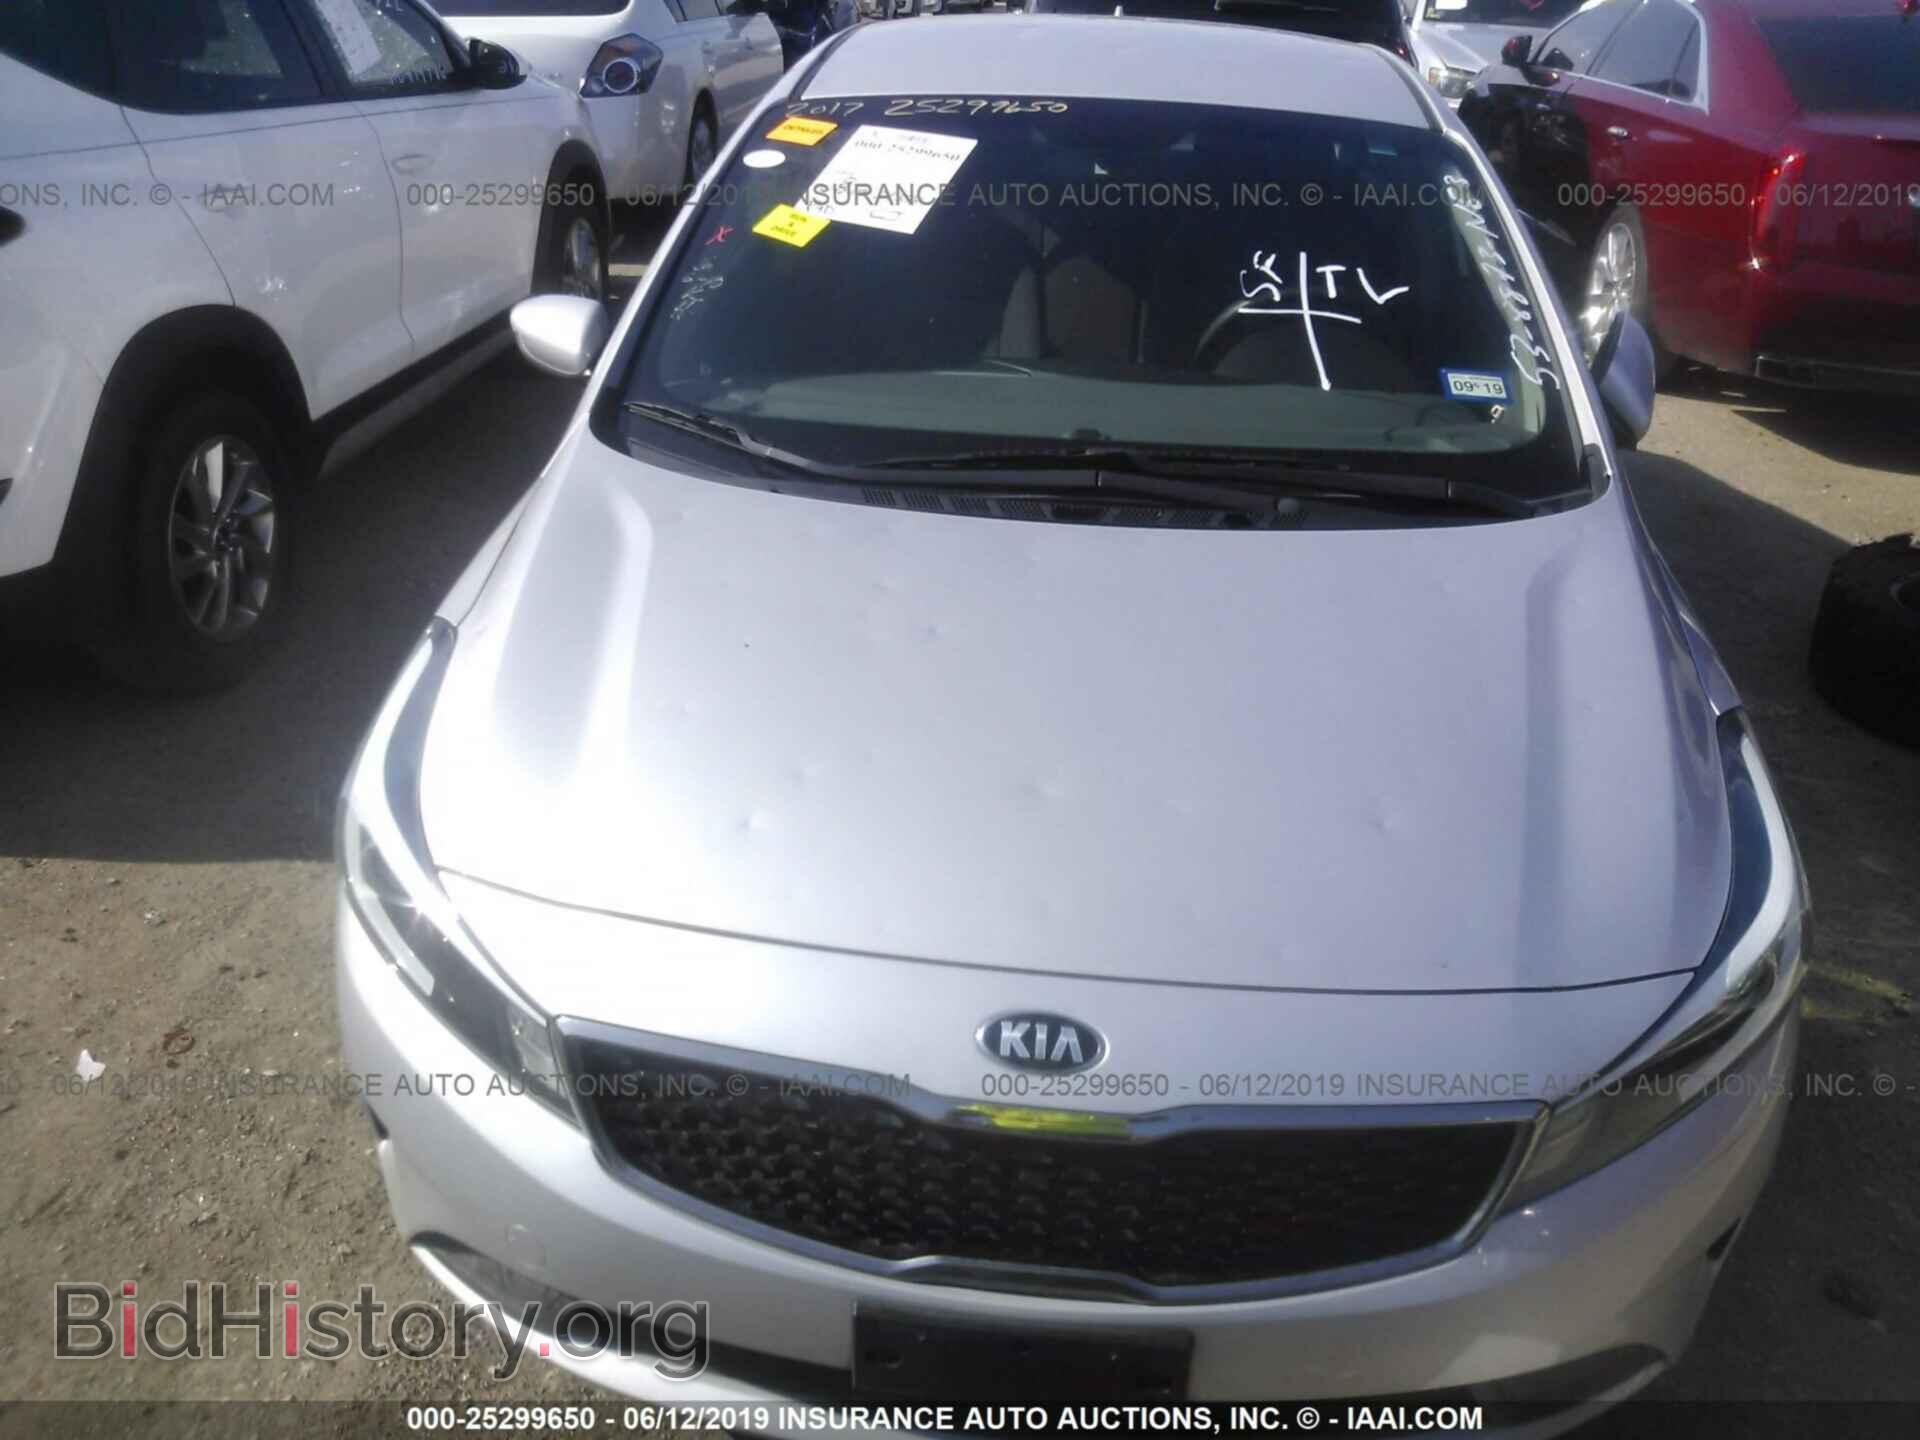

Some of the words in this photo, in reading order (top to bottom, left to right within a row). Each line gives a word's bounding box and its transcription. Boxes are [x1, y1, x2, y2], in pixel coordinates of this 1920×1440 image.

[785, 101, 864, 118] 2017
[884, 99, 1068, 116] 25299650
[1000, 1020, 1084, 1063] KIA
